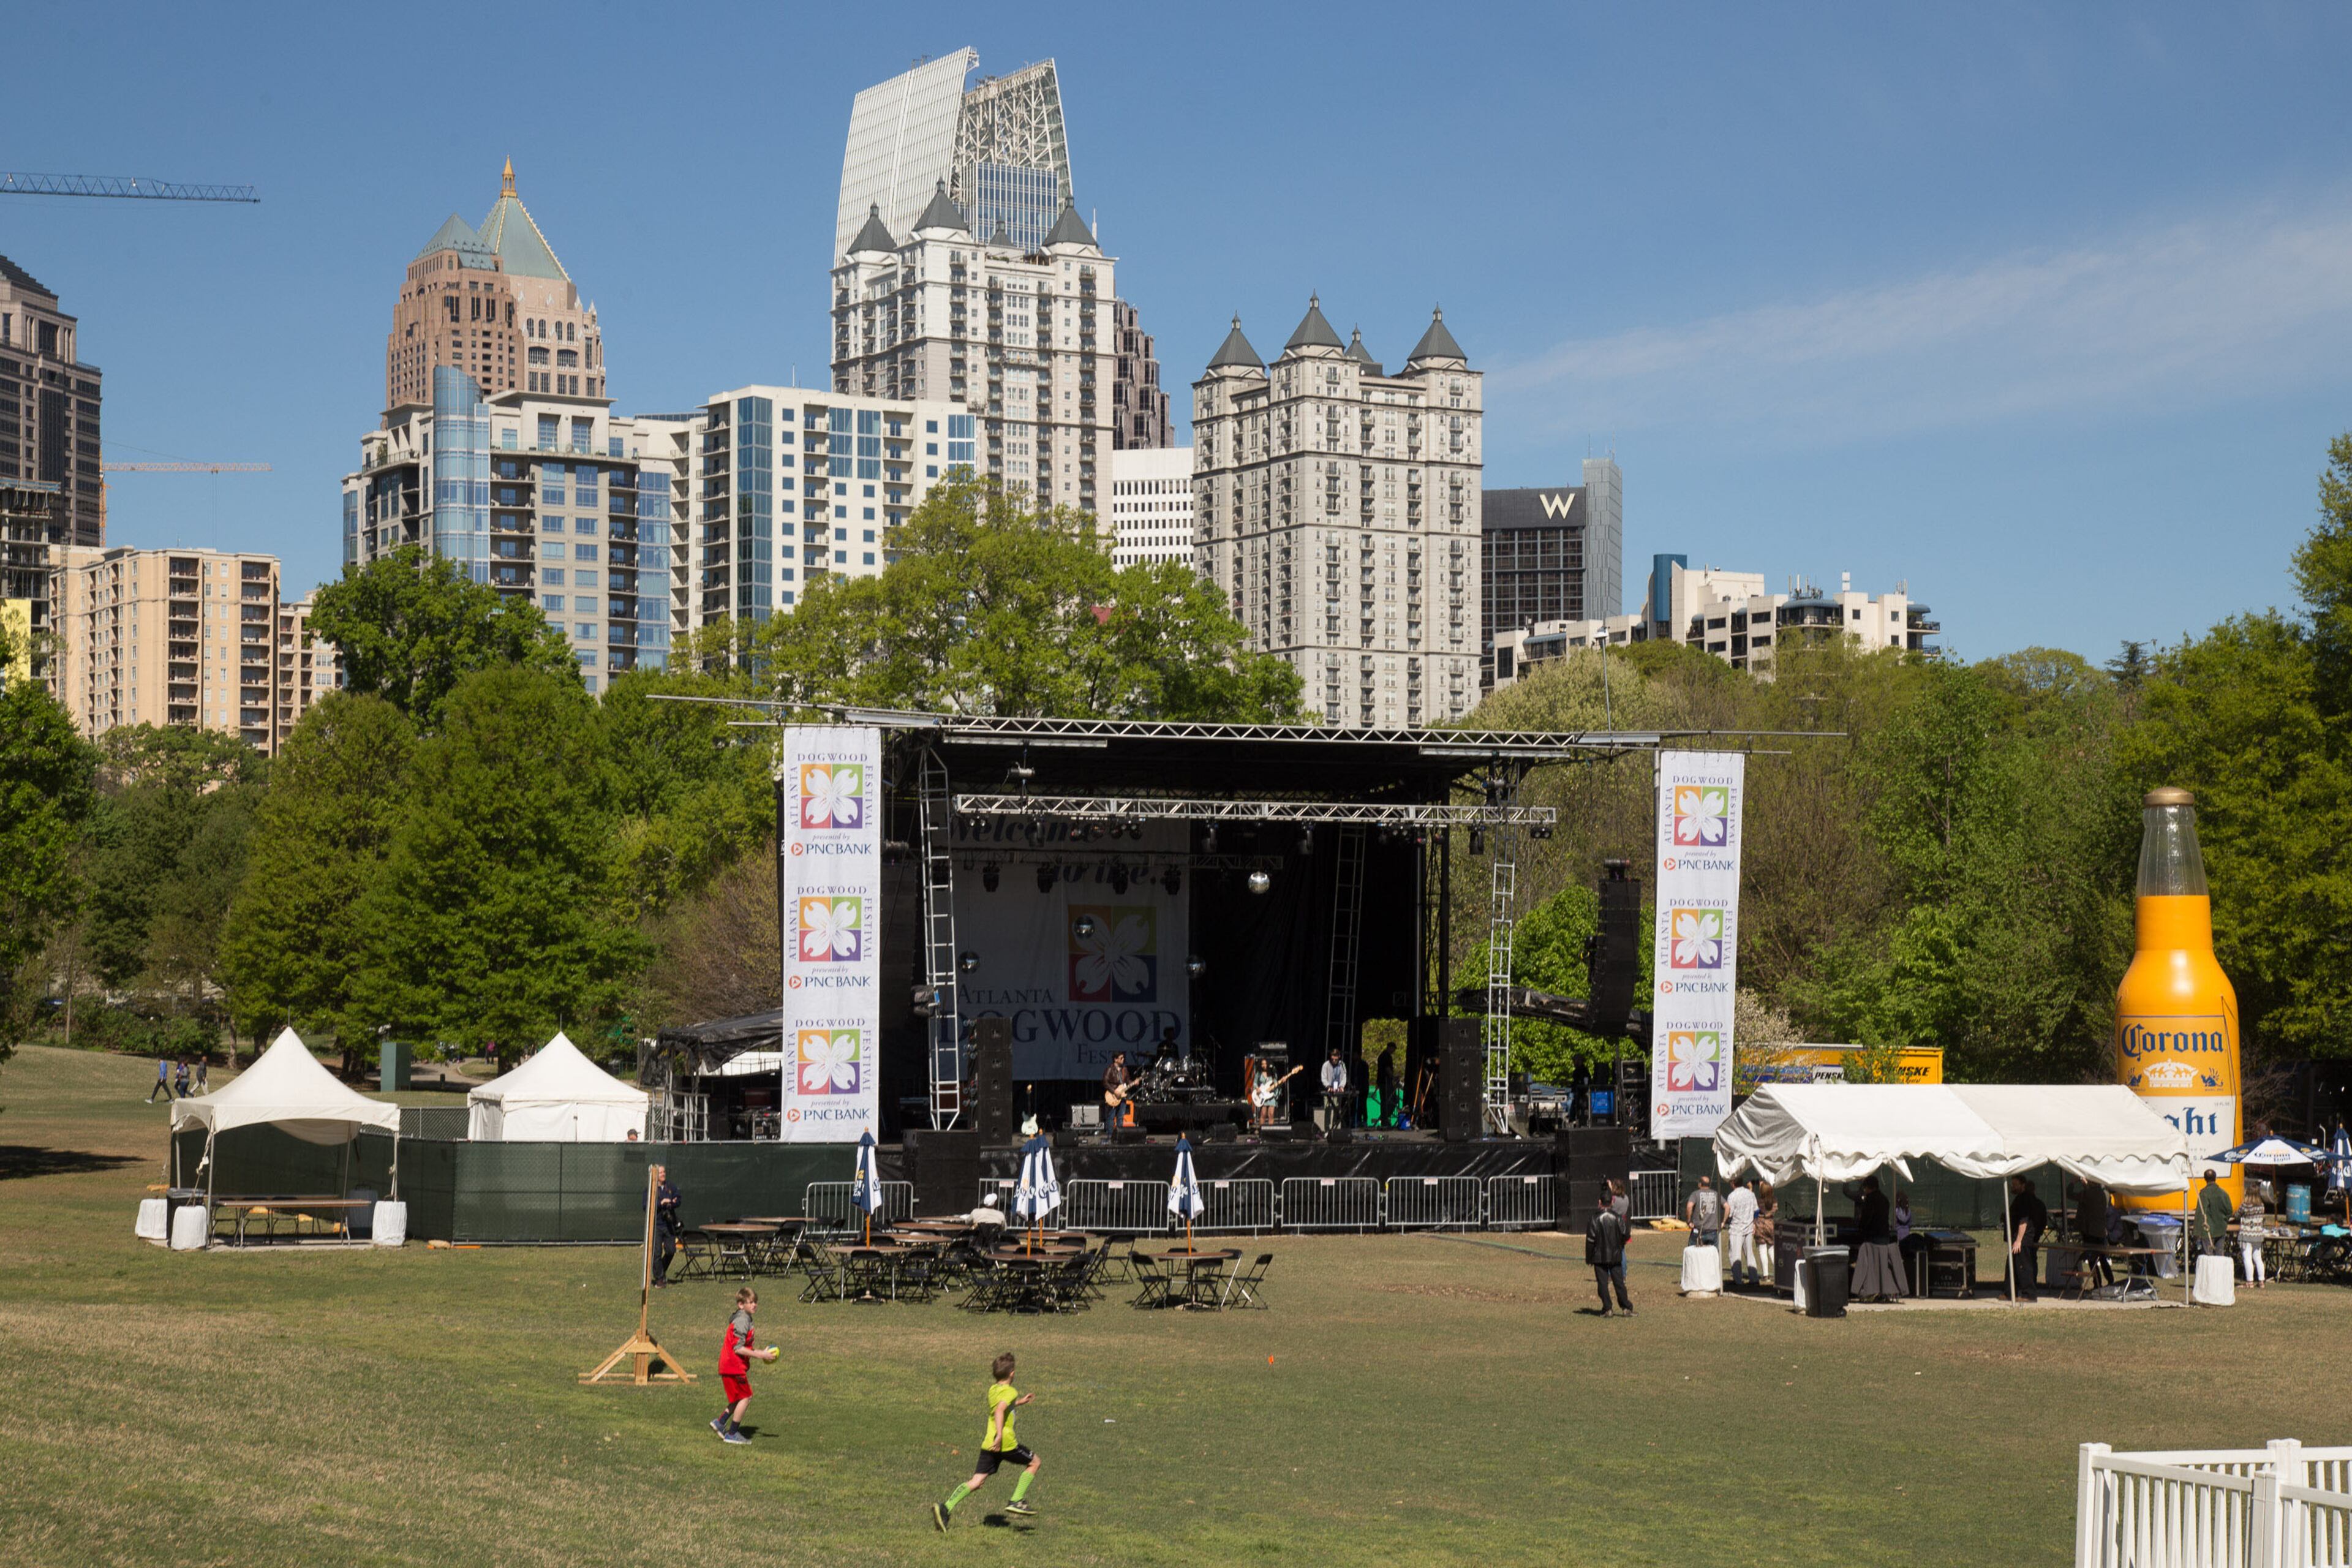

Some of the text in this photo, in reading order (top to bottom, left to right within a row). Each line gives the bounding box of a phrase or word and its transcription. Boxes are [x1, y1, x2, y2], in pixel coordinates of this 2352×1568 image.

[1539, 493, 1576, 520] W
[797, 753, 868, 761] DOGWOOD
[1673, 775, 1733, 785] DOGWOOD
[790, 766, 798, 827] ATLANTA
[1664, 787, 1673, 843] ATLANTA
[797, 886, 867, 895] DOGWOOD
[789, 900, 797, 960] ATLANTA
[864, 898, 872, 960] FESTIVAL
[1661, 911, 1670, 967] ATLANTA
[1724, 910, 1733, 968] FESTIVAL
[959, 984, 1054, 1004] ATLANTA
[796, 1018, 865, 1027] DOGWOOD
[938, 1009, 1182, 1042] DGWOOD
[2121, 1023, 2223, 1062] Corona
[862, 1030, 871, 1093] FESTIVAL
[1657, 1033, 1666, 1089] ATLANTA
